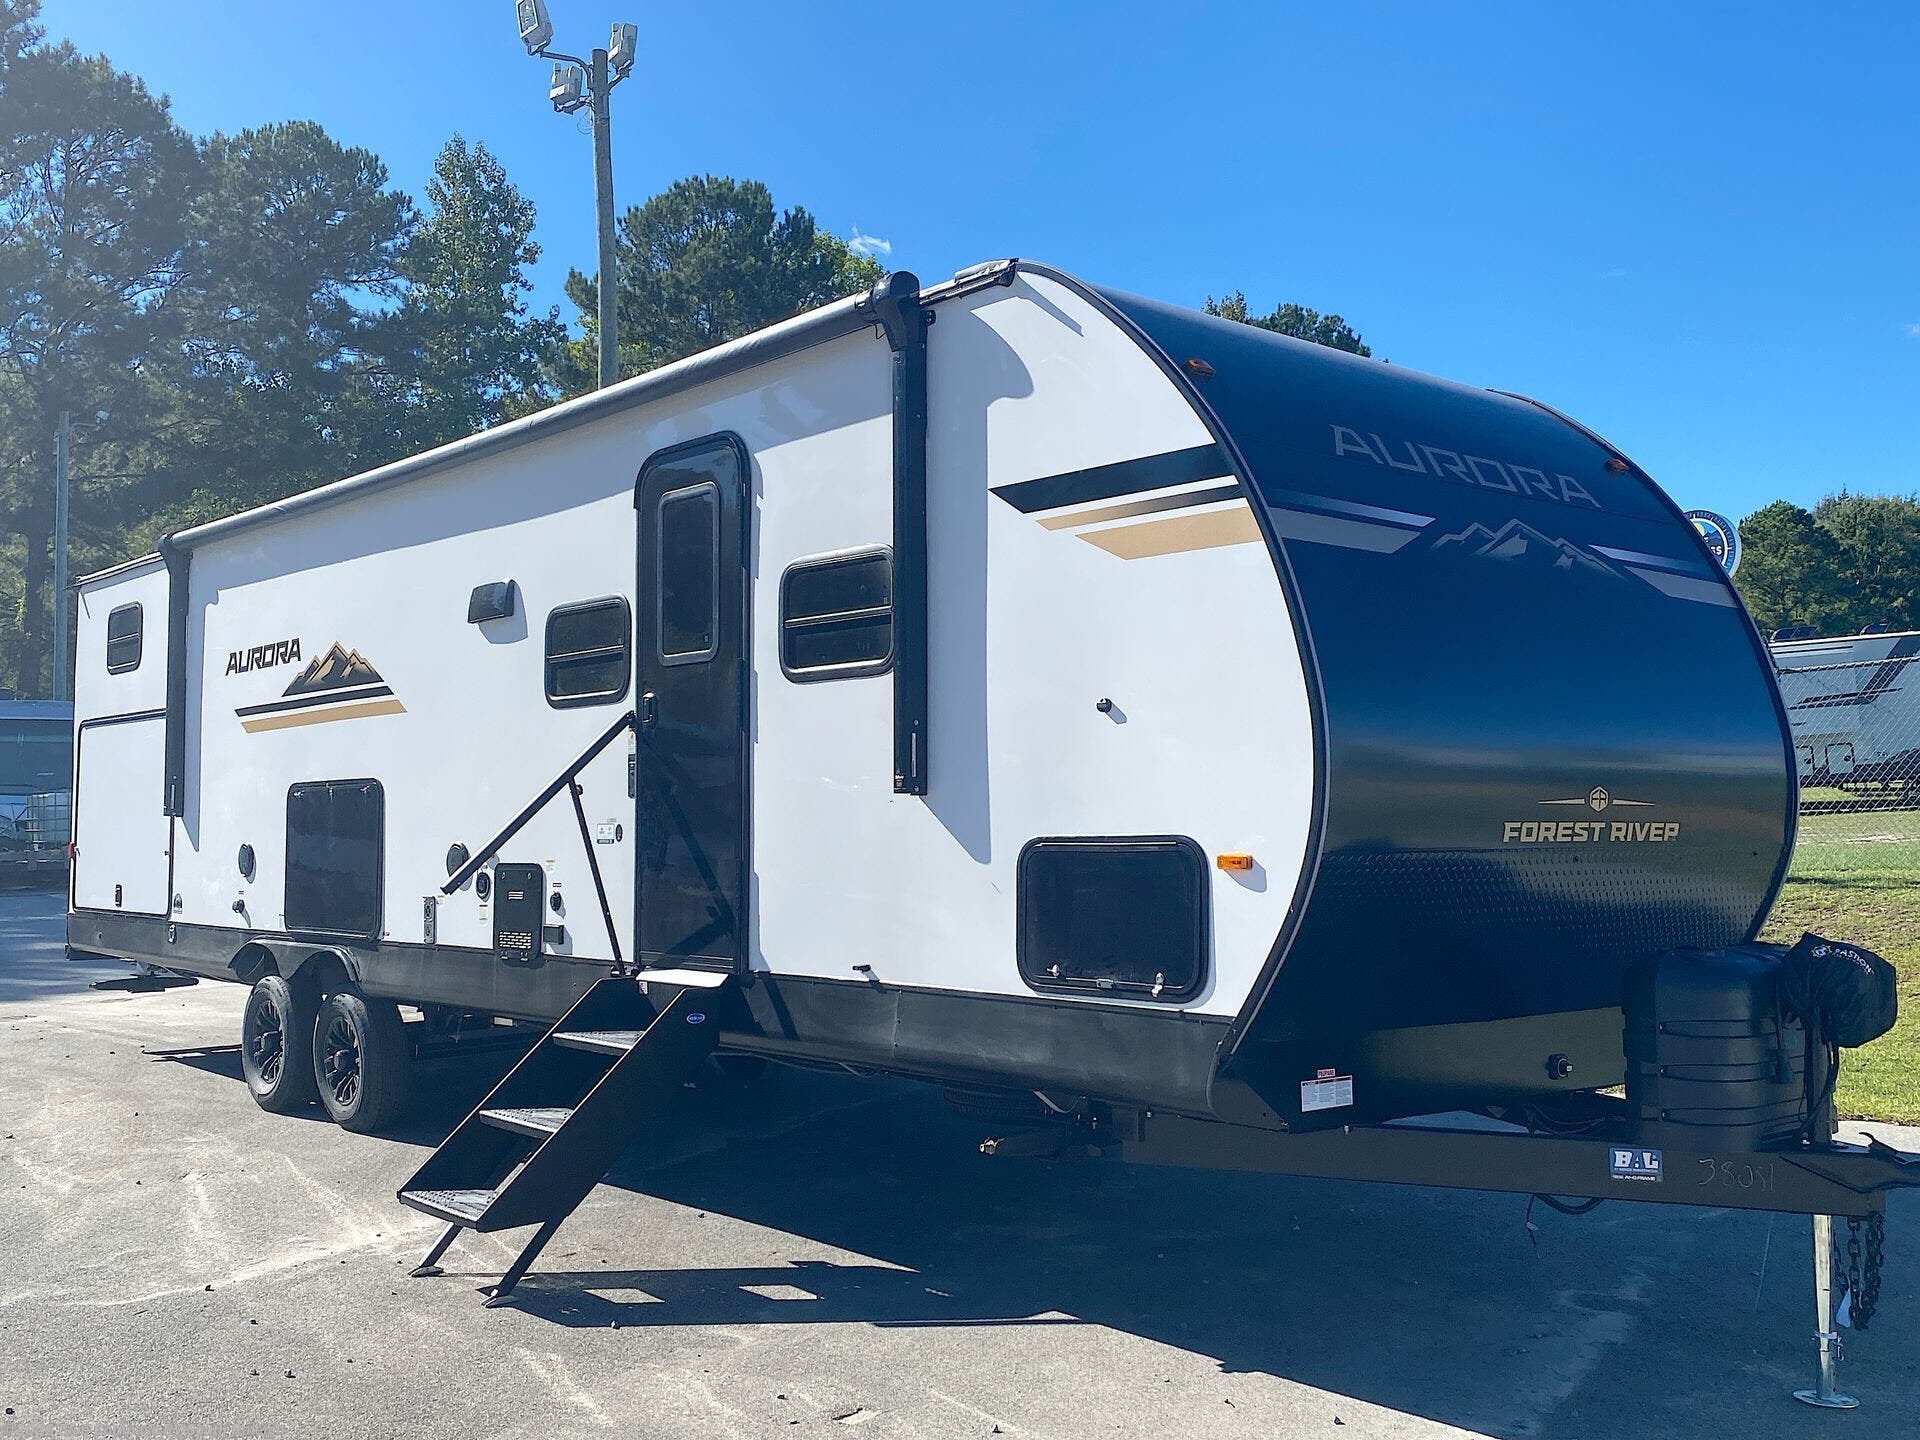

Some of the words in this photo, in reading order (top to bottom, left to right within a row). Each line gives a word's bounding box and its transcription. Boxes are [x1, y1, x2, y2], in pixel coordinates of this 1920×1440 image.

[1328, 423, 1603, 509] AURORA
[225, 637, 302, 677] AURORA
[1503, 820, 1606, 843] FOREST
[1614, 1150, 1659, 1169] BAL
